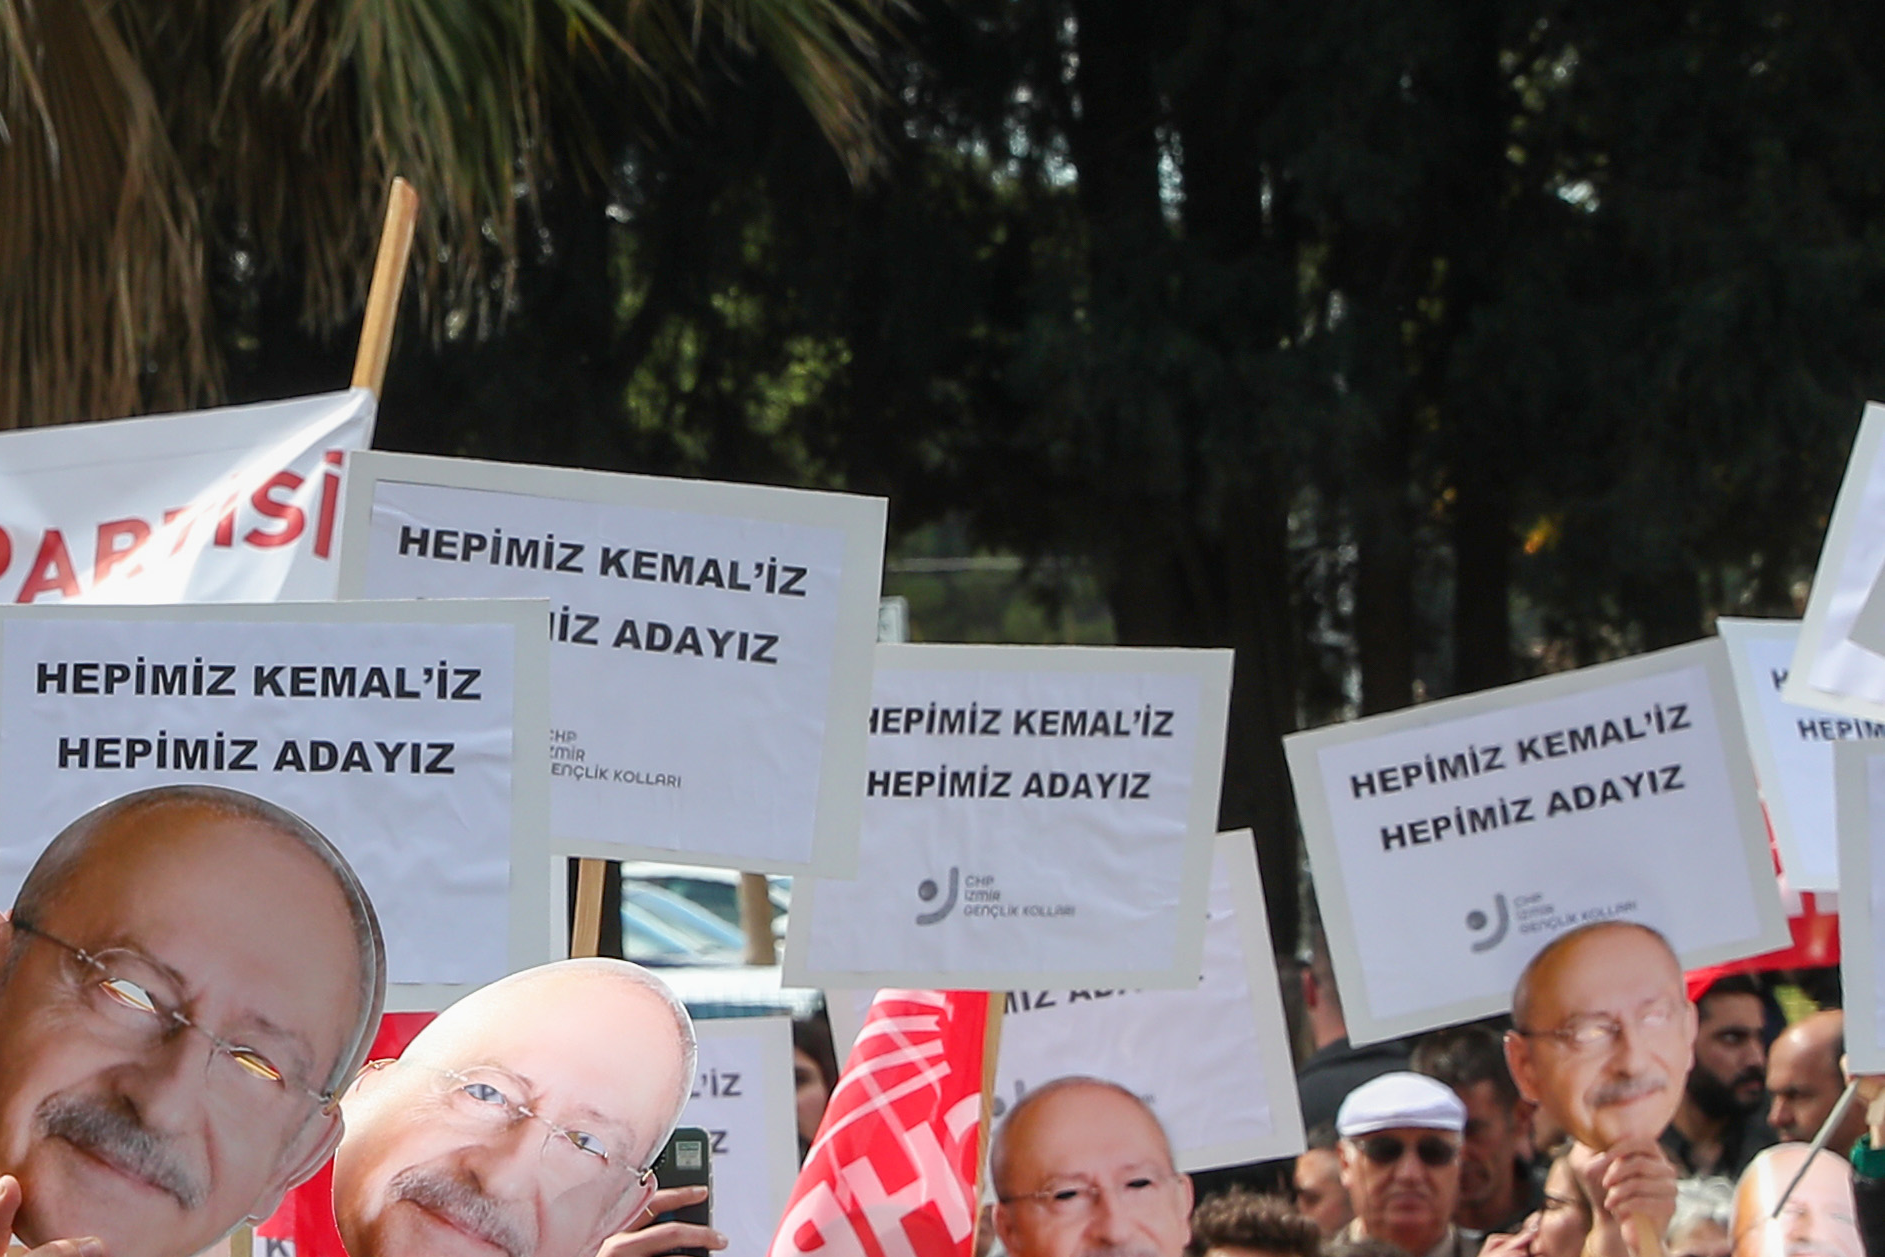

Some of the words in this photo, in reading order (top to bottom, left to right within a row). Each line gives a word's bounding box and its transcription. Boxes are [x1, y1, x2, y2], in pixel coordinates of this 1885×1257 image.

[398, 527, 584, 573] HEPİMİZ
[599, 546, 808, 597] KEMAL’İZ
[613, 619, 779, 664] ADAYIZ
[36, 656, 236, 696] HEPİMİZ
[254, 660, 481, 700] KEMAL’İZ
[1014, 703, 1174, 737] KEMAL’İZ
[59, 731, 258, 771] HEPİMİZ
[274, 740, 455, 774] ADAYIZ
[1351, 745, 1505, 799] HEPİMİZ
[1517, 704, 1692, 764] KEMAL’İZ
[614, 769, 681, 788] KOLLARI
[867, 764, 1012, 798] HEPİMİZ
[1021, 772, 1151, 800] ADAYIZ
[1380, 797, 1534, 851] HEPİMİZ
[1547, 764, 1685, 817] ADAYIZ
